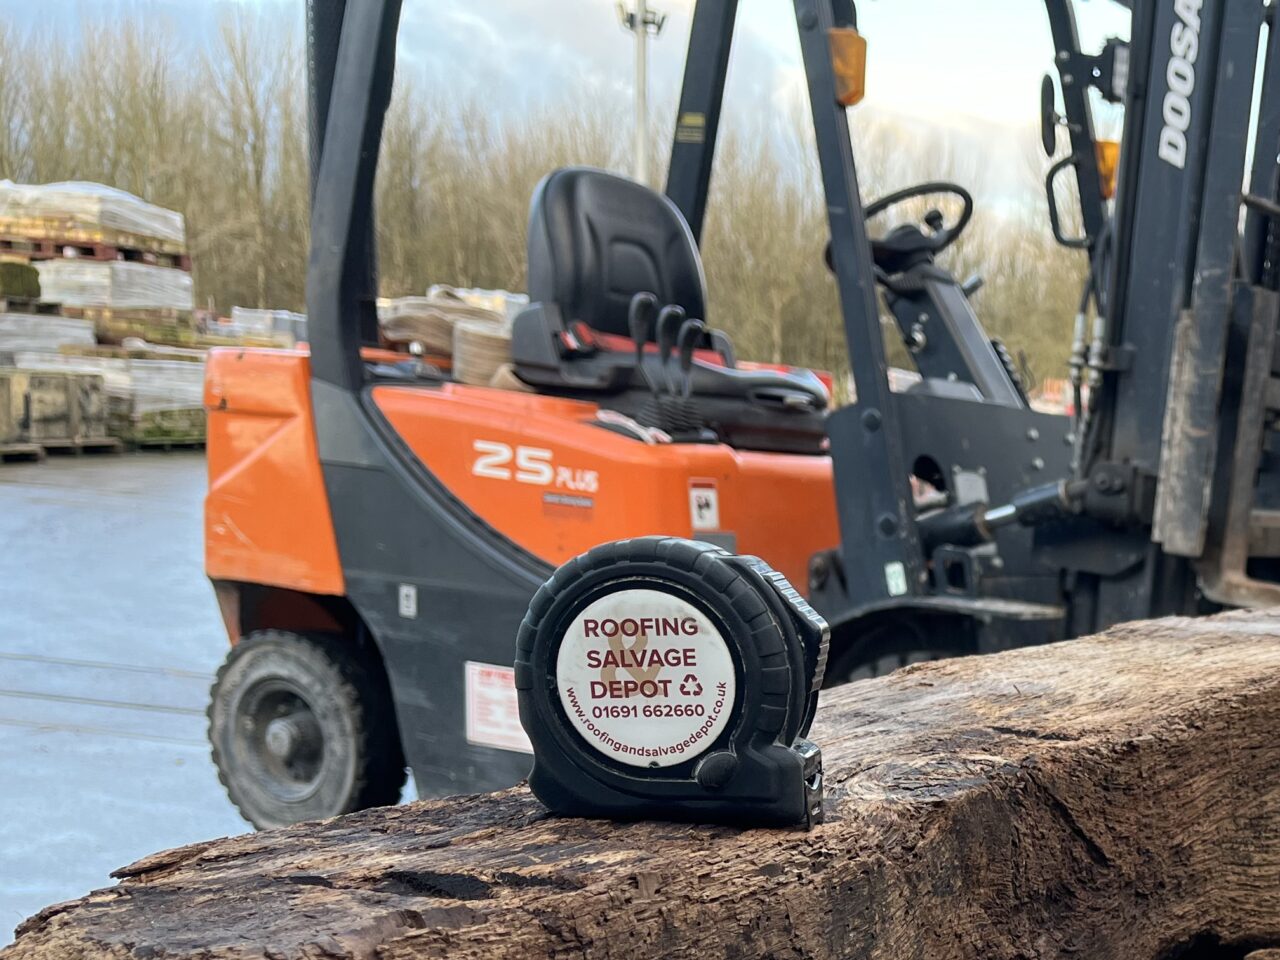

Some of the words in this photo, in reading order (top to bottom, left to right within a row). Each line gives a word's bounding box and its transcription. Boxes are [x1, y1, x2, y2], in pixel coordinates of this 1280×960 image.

[472, 438, 554, 485] 25
[555, 465, 600, 493] PLUS
[583, 617, 699, 637] ROOFING
[586, 648, 697, 668] SALVAGE
[600, 621, 665, 698] &
[590, 679, 672, 698] DEPOT
[566, 681, 727, 757] www.roofingandsalvagedepot.co.uk
[592, 705, 638, 718] 01691
[642, 704, 705, 718] 662660
